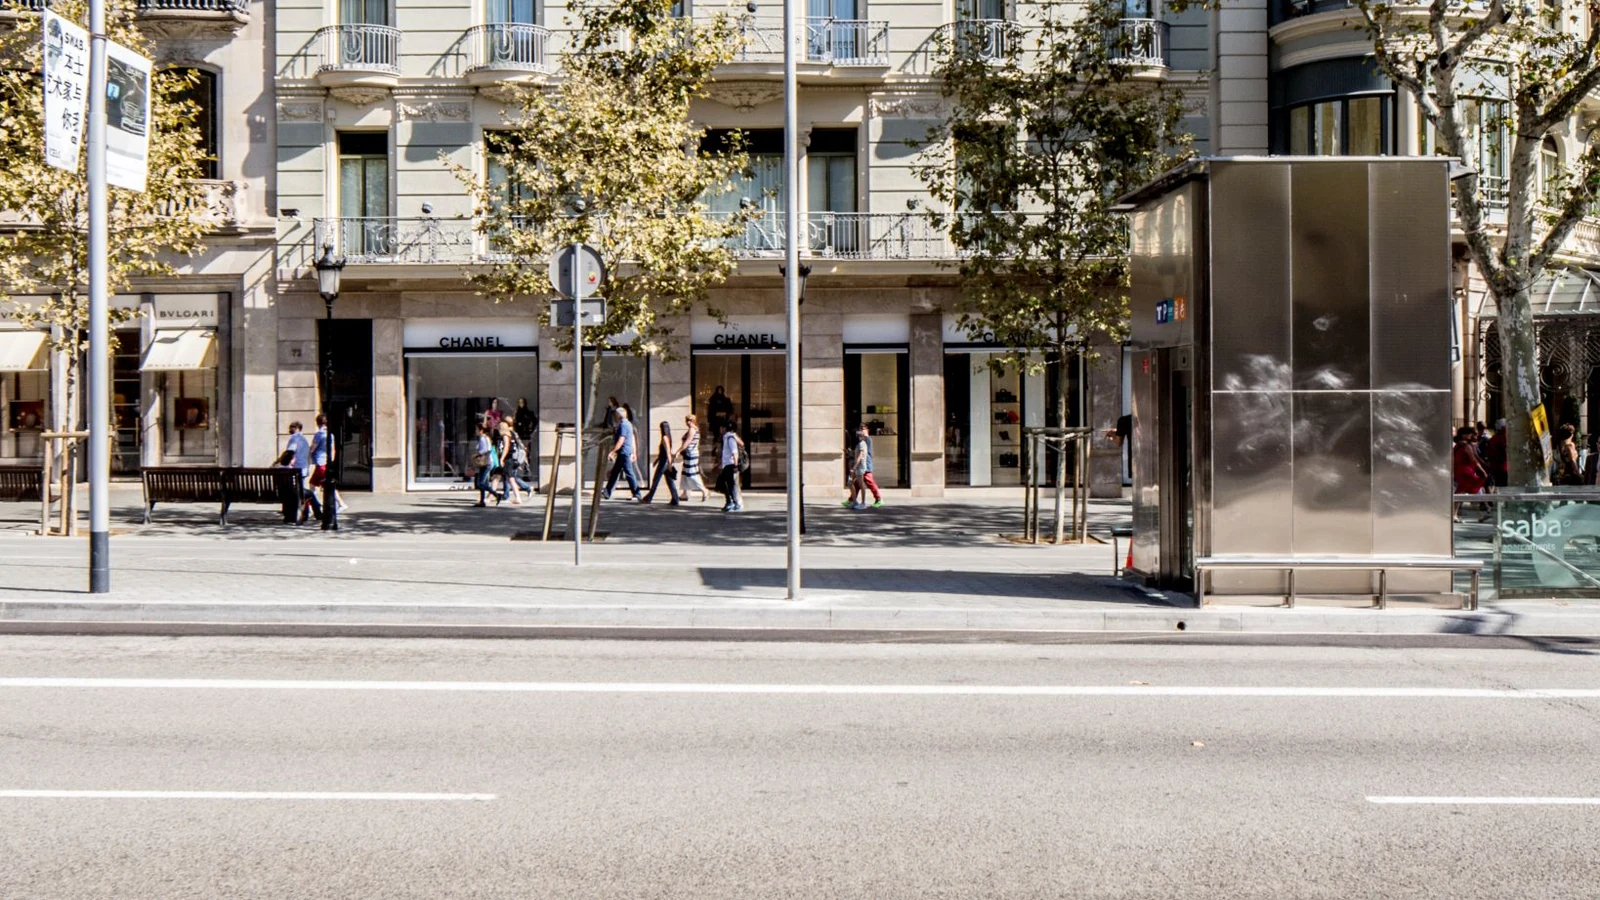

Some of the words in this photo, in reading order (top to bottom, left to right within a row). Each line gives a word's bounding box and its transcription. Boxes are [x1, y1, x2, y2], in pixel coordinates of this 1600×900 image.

[439, 336, 504, 348] CHANEL
[713, 333, 779, 344] CHANEL
[1502, 513, 1562, 538] saba
